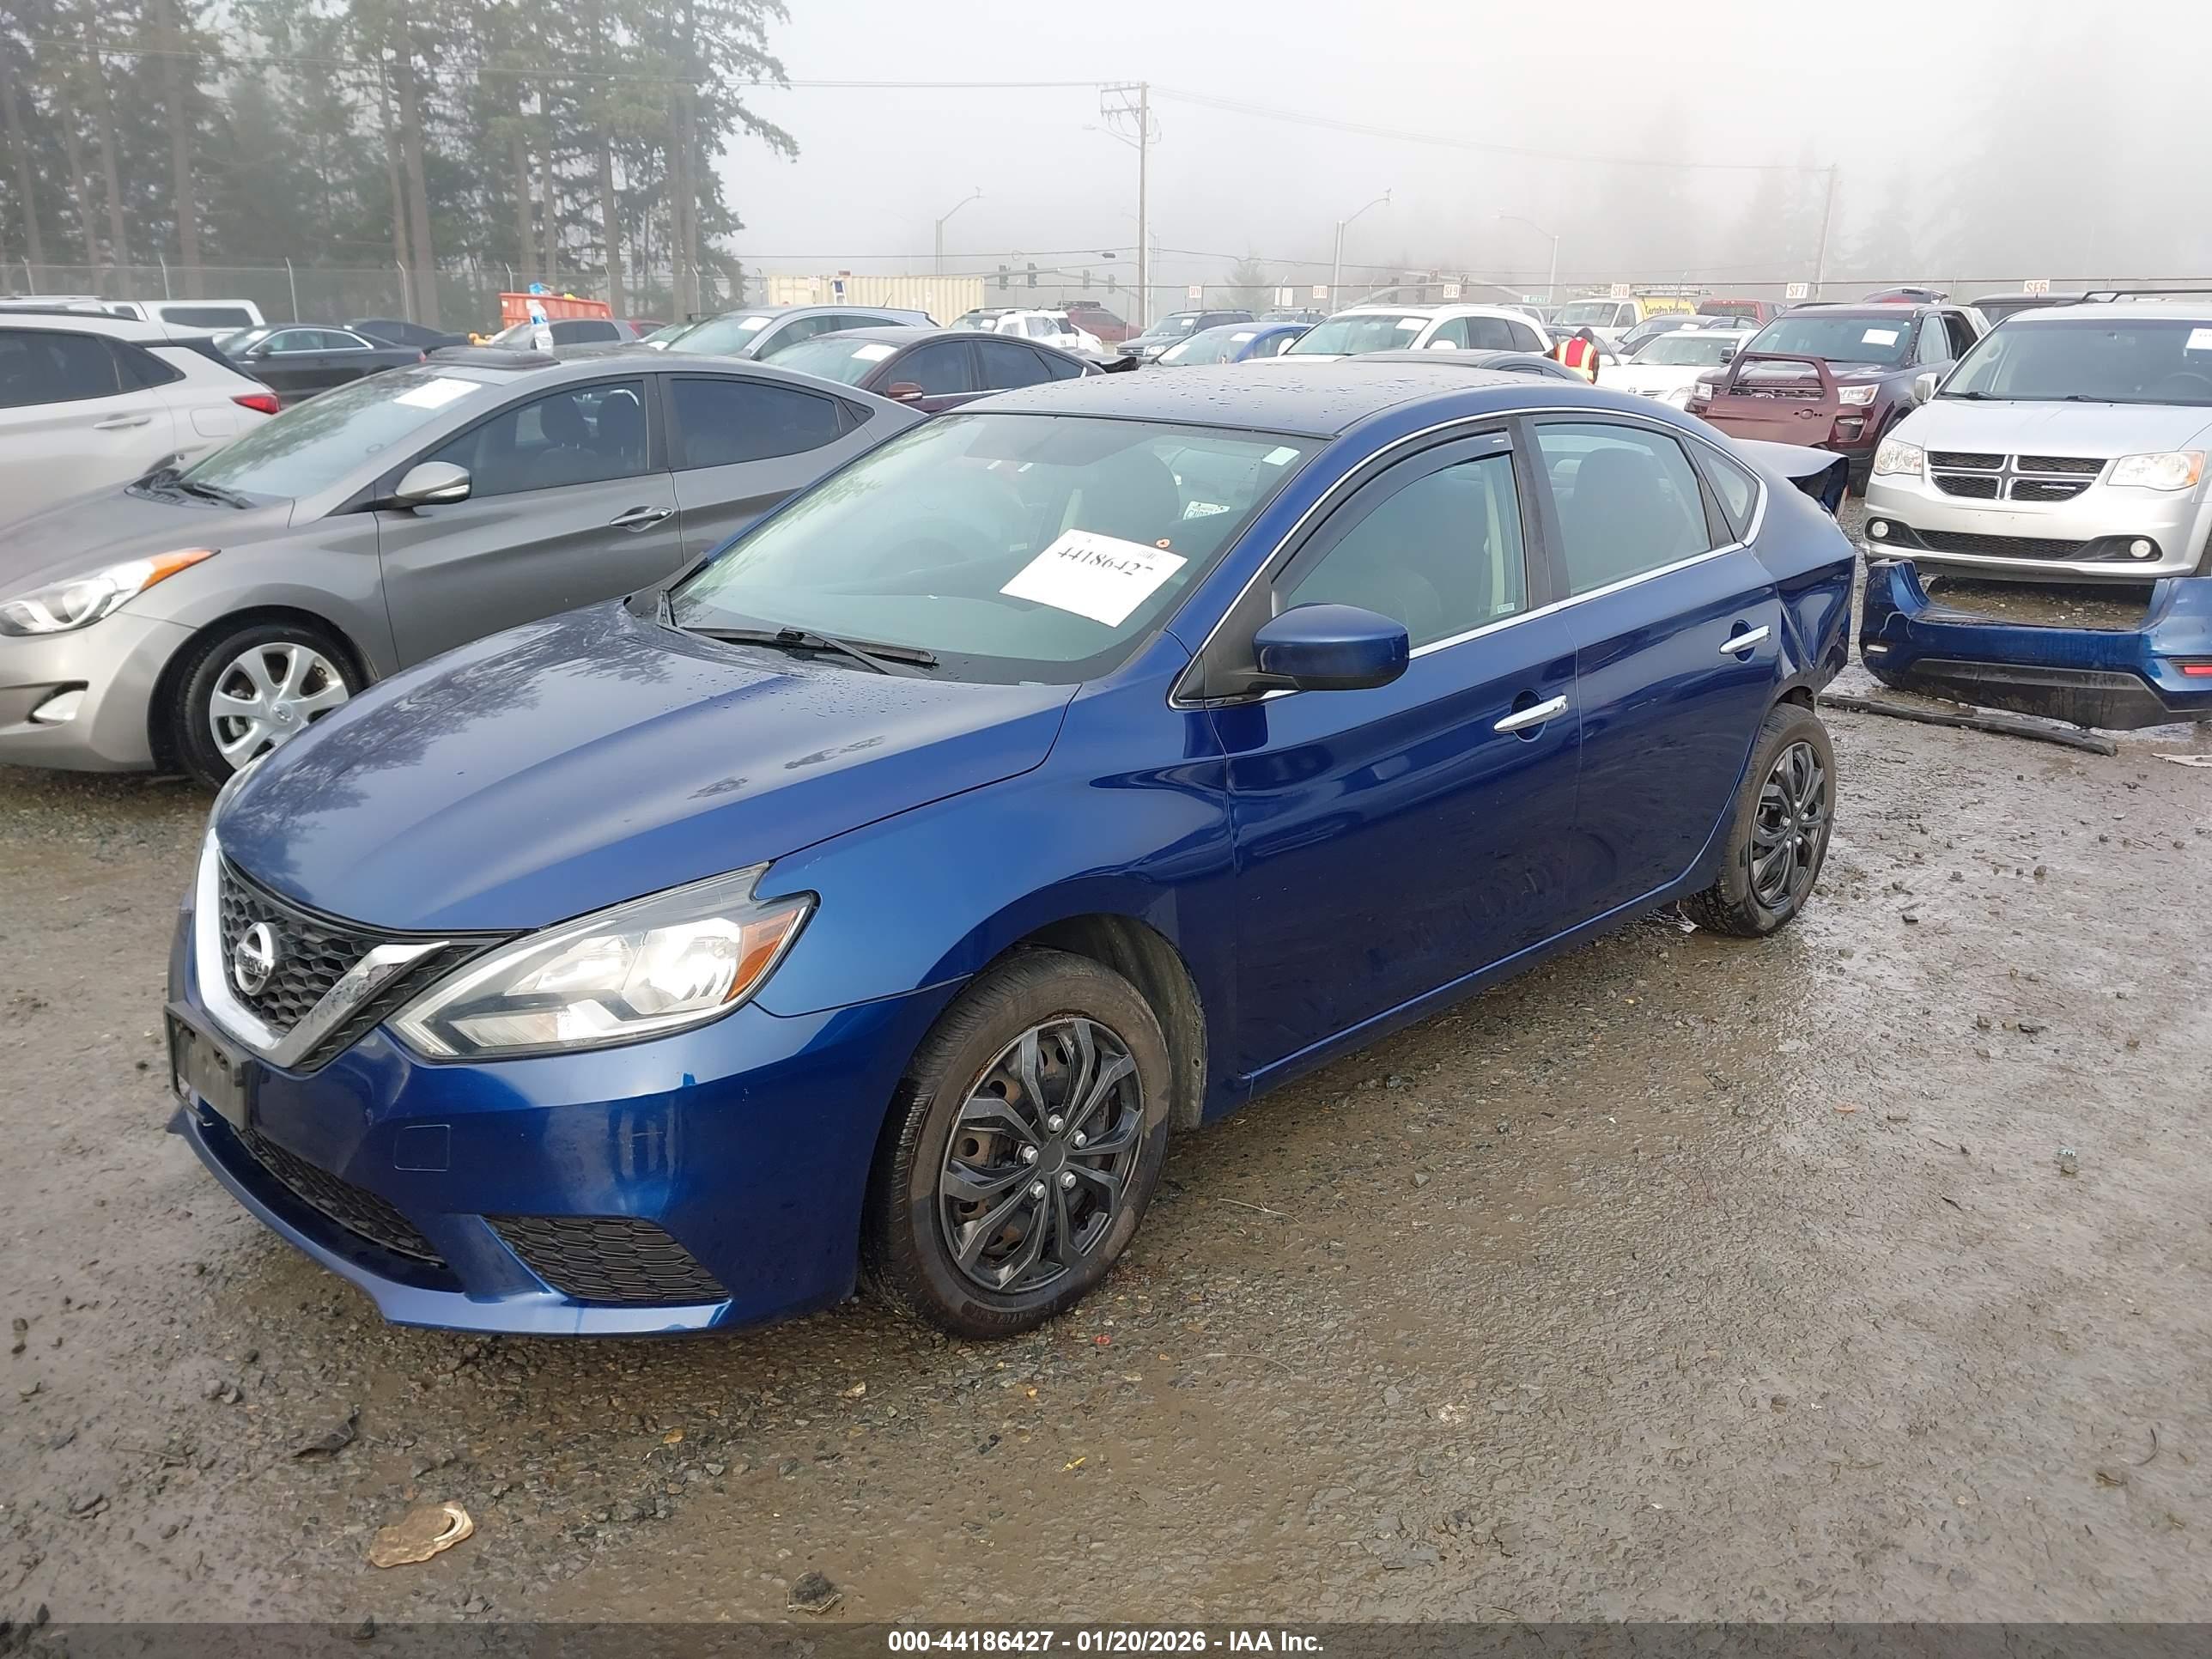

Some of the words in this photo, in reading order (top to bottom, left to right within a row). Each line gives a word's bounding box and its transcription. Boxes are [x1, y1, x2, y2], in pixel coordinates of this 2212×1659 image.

[1444, 286, 1457, 296] SF9
[1789, 284, 1807, 297] SF7
[2026, 282, 2047, 295] SF6
